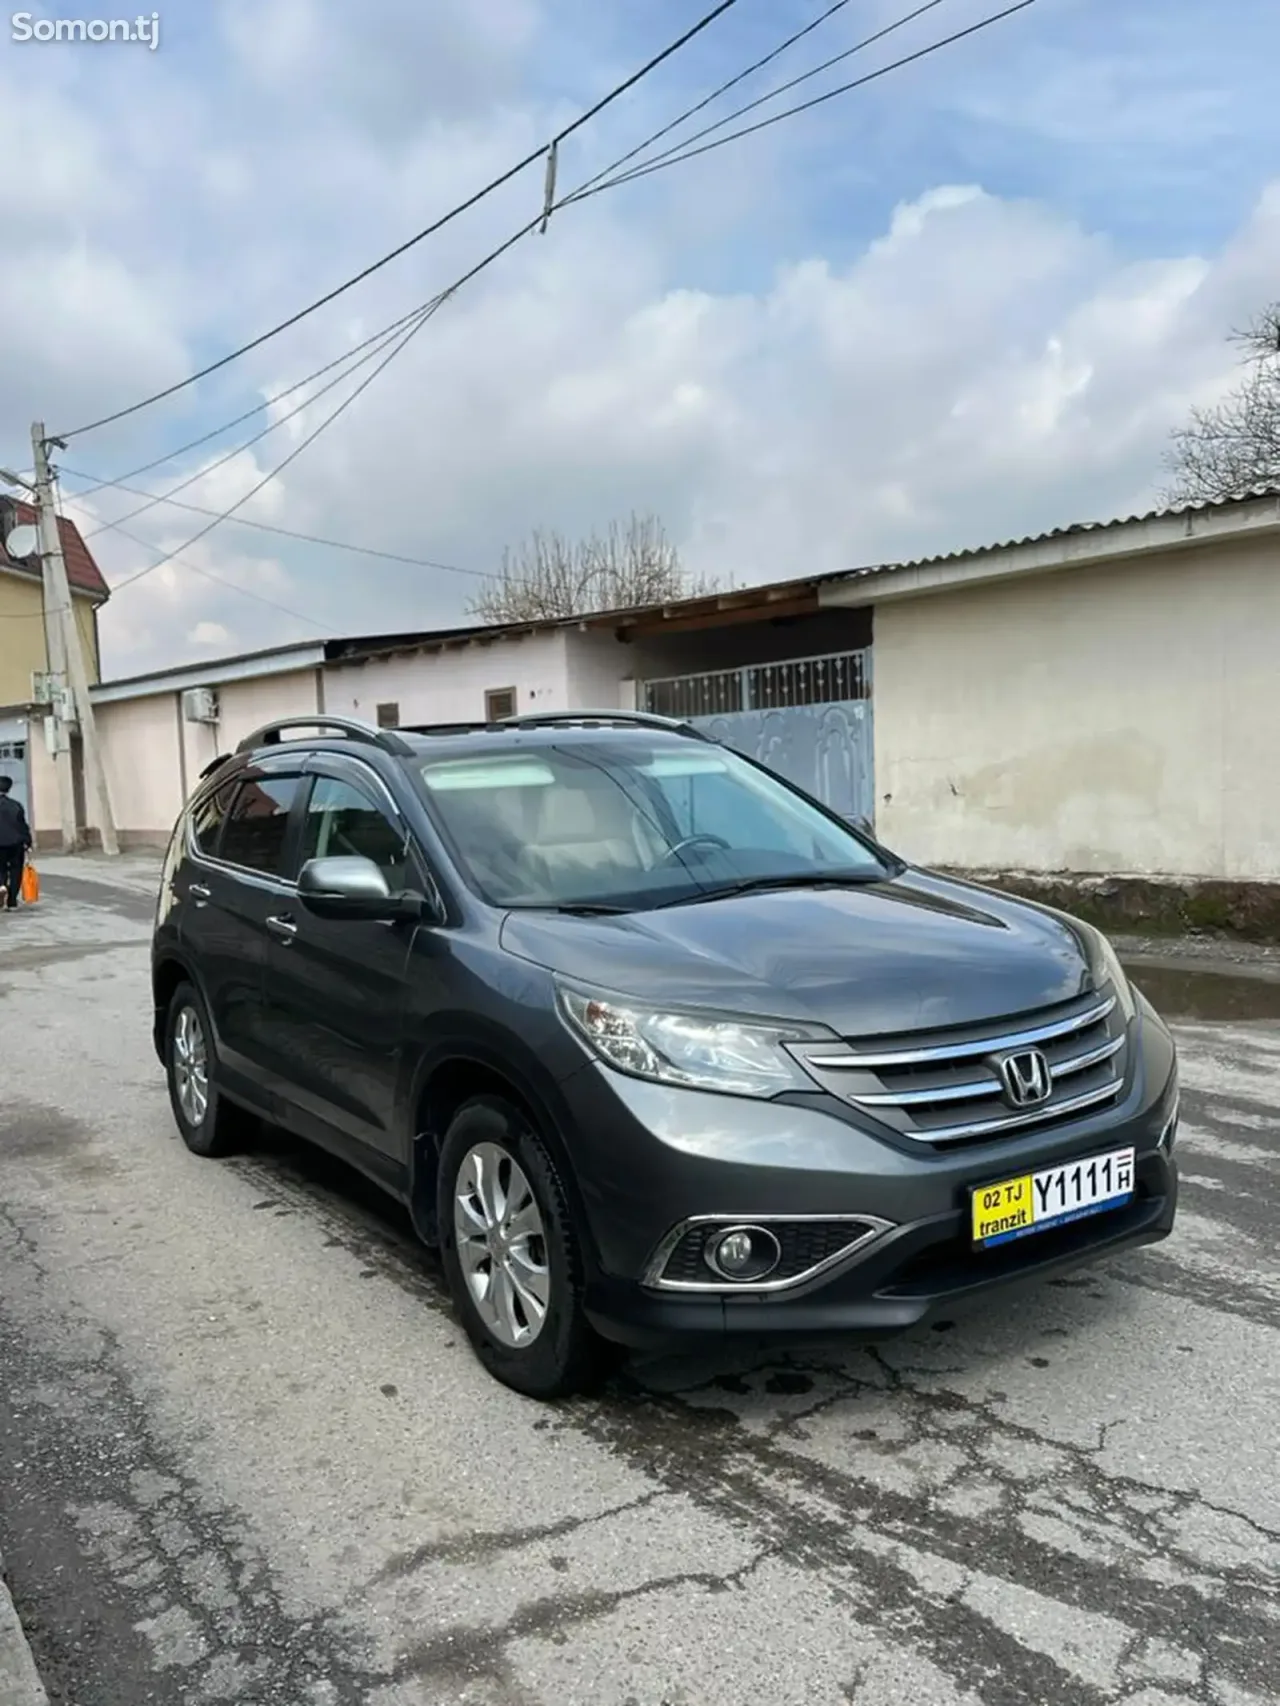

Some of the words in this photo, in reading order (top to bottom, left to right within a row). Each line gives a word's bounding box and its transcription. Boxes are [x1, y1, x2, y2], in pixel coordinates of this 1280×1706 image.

[1034, 1158, 1112, 1212] Y1111
[1118, 1170, 1130, 1190] H
[983, 1190, 1001, 1210] 02
[1005, 1184, 1023, 1204] TJ
[980, 1208, 1027, 1236] tranzit
